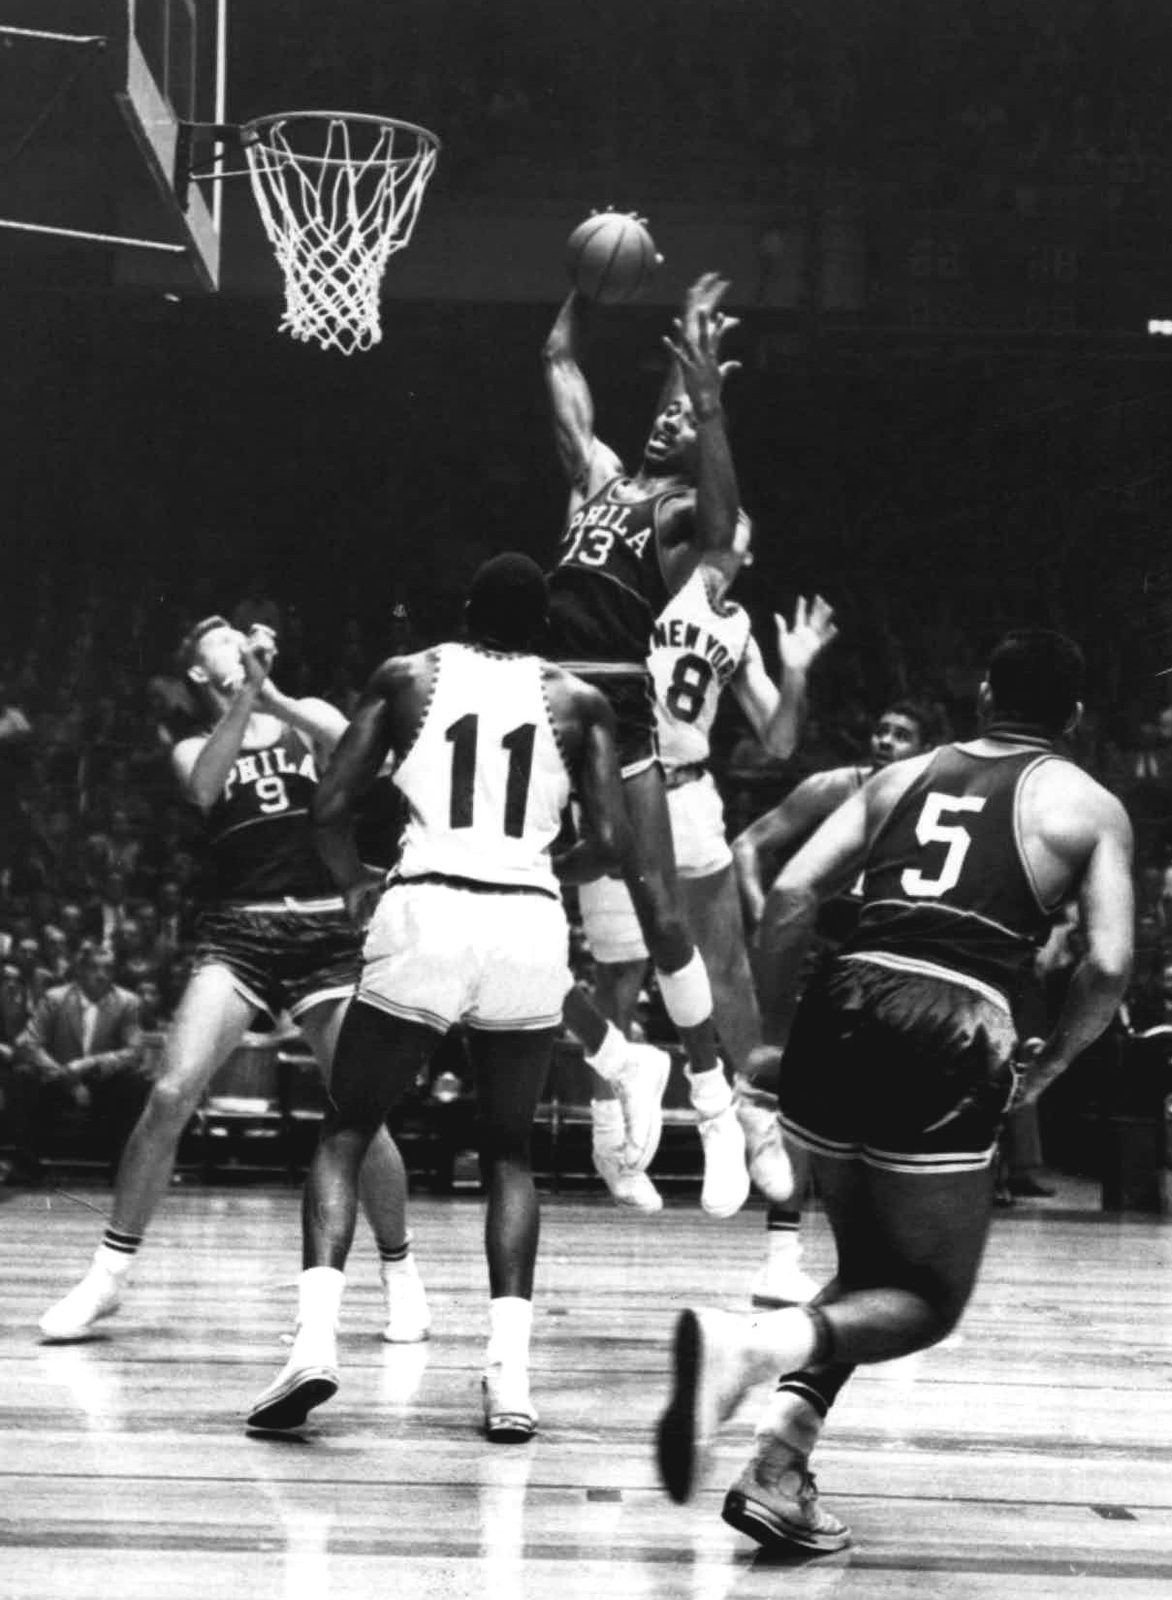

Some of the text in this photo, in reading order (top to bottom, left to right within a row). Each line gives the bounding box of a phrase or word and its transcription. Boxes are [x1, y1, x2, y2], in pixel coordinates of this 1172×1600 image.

[559, 529, 615, 567] 13
[562, 504, 652, 559] PHILA
[652, 619, 736, 687] NEW YOR
[666, 653, 713, 724] 8
[225, 747, 319, 801] PHILA
[255, 776, 290, 813] 9
[445, 713, 537, 839] 11
[900, 791, 987, 898] 5
